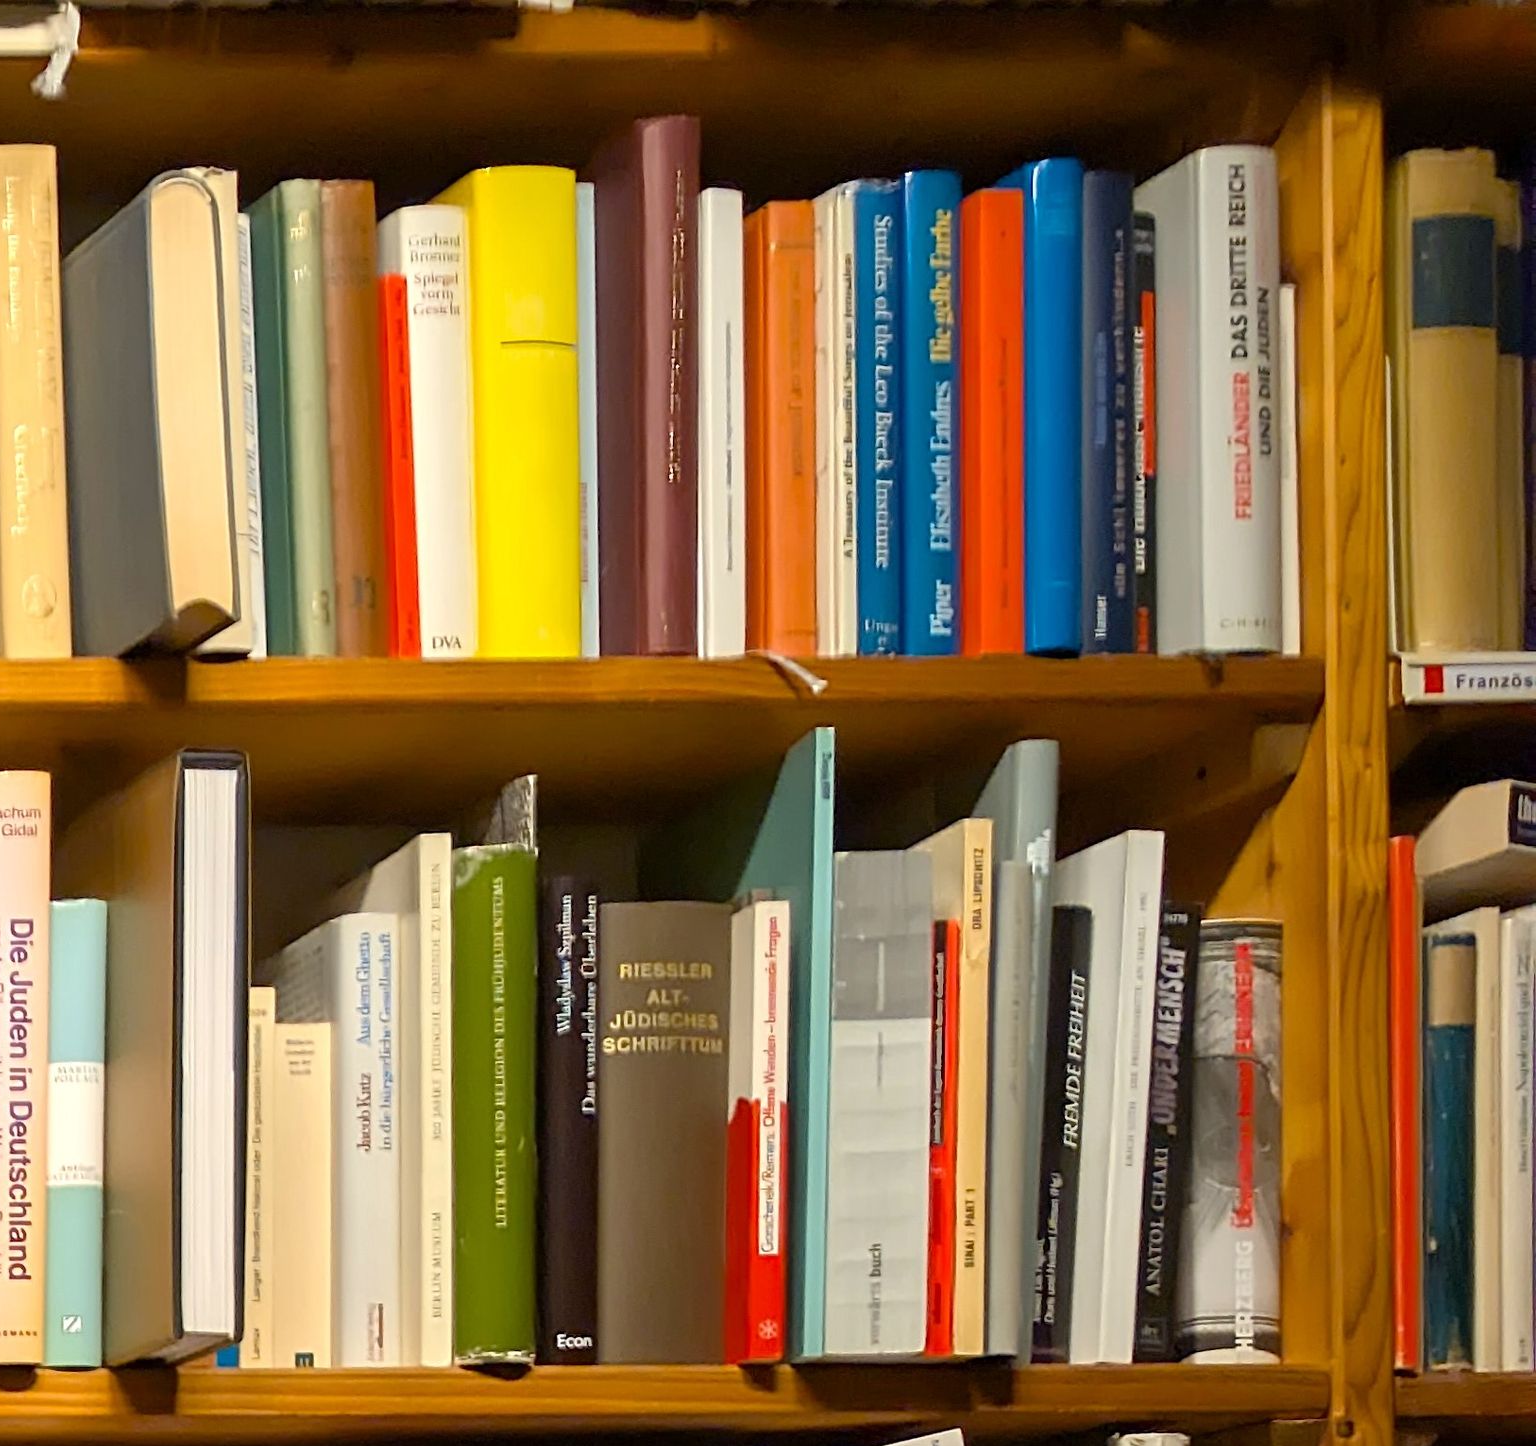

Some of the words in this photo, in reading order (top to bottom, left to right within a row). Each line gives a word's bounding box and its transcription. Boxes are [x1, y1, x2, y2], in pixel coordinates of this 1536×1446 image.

[1228, 164, 1246, 226] REICH
[930, 210, 952, 266] Farbe
[930, 271, 955, 327] gelbe
[1229, 236, 1247, 306] DRITTE
[930, 330, 952, 362] Die
[1230, 315, 1248, 359] DAS
[930, 381, 951, 450] Endres
[1228, 372, 1252, 520] FRIEDLÄNDER
[930, 455, 951, 550] Elisabeth
[930, 580, 955, 637] Piper
[8, 919, 34, 963] Die
[8, 971, 34, 1058] Juden
[8, 1066, 32, 1091] in
[7, 1101, 33, 1281] Deutschland
